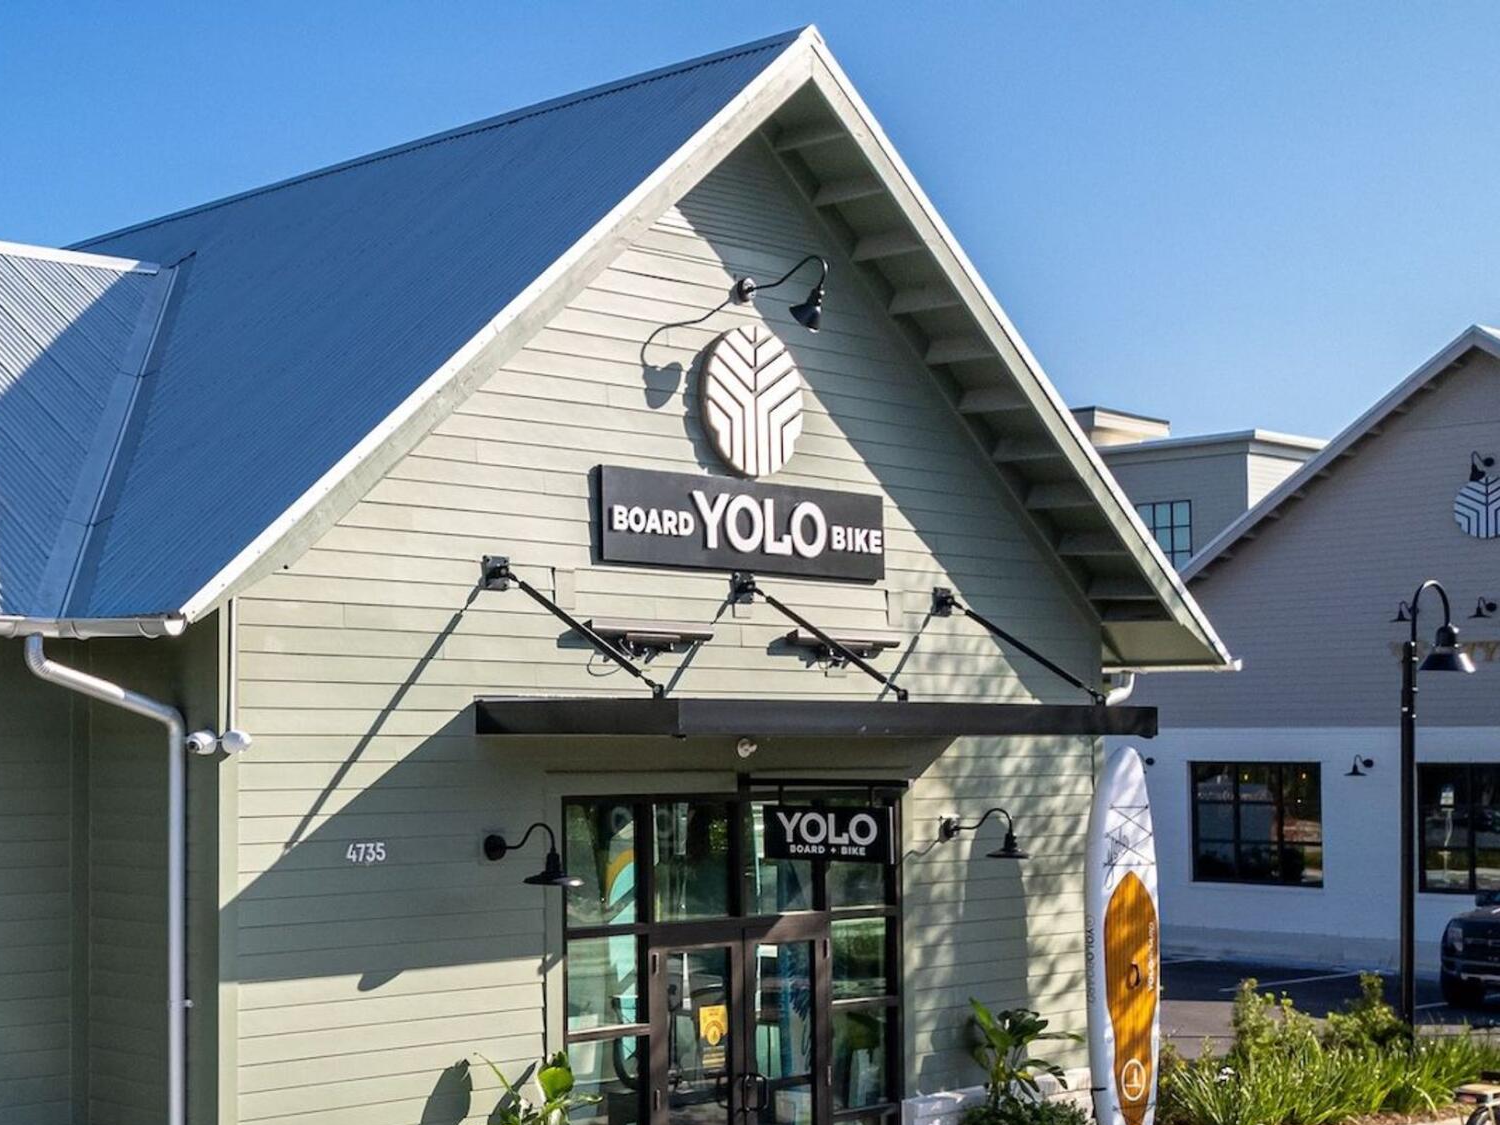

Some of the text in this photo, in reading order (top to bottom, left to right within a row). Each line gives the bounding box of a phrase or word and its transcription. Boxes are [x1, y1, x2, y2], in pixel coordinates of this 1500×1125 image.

[612, 490, 882, 559] BOARD YOLO BIKE
[776, 812, 878, 846] YOLO
[346, 842, 386, 862] 4735
[789, 844, 826, 854] BOARD
[841, 846, 866, 856] BIKE
